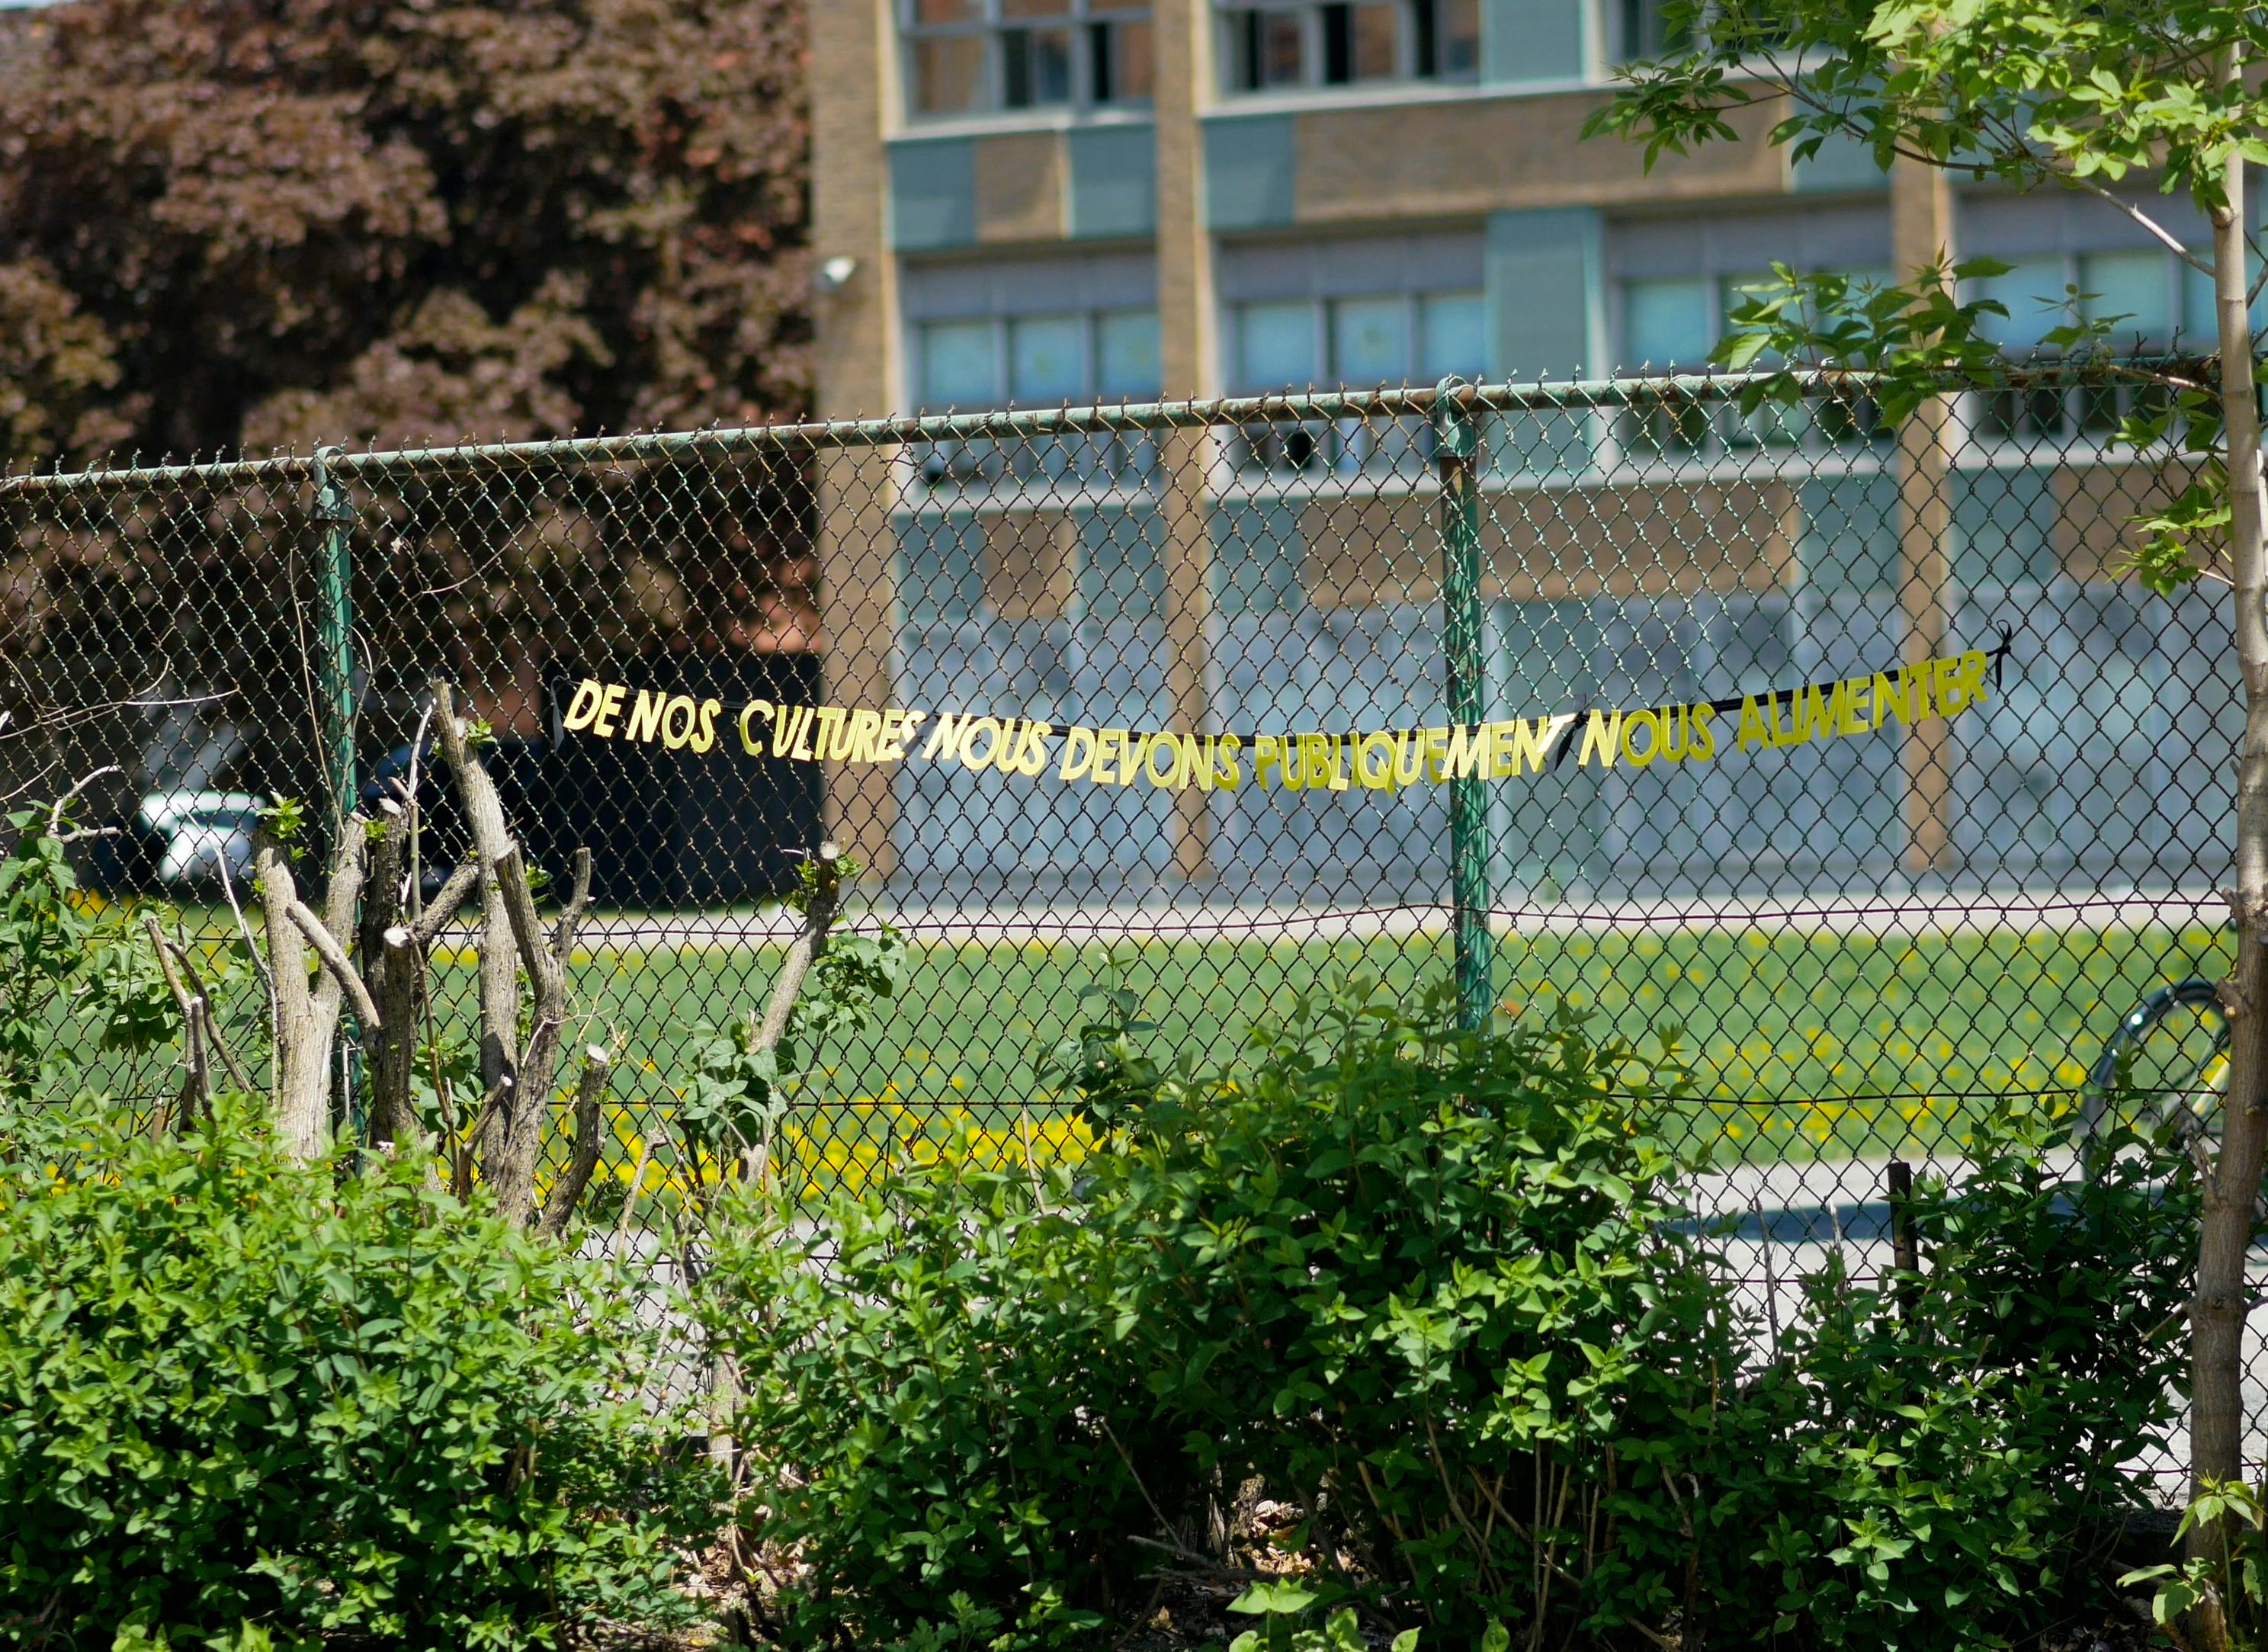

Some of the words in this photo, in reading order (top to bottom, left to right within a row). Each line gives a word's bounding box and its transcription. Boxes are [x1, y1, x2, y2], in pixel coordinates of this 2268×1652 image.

[563, 678, 627, 738] DE
[626, 689, 721, 753] NOS
[739, 699, 926, 763] CULTURES
[922, 712, 1052, 776] NOUS
[1059, 727, 1241, 791] DEVONS
[1255, 713, 1577, 797] PUBLIQUEMENT
[1578, 701, 1715, 767] NOUS
[1737, 650, 1987, 752] ALIMENTER
